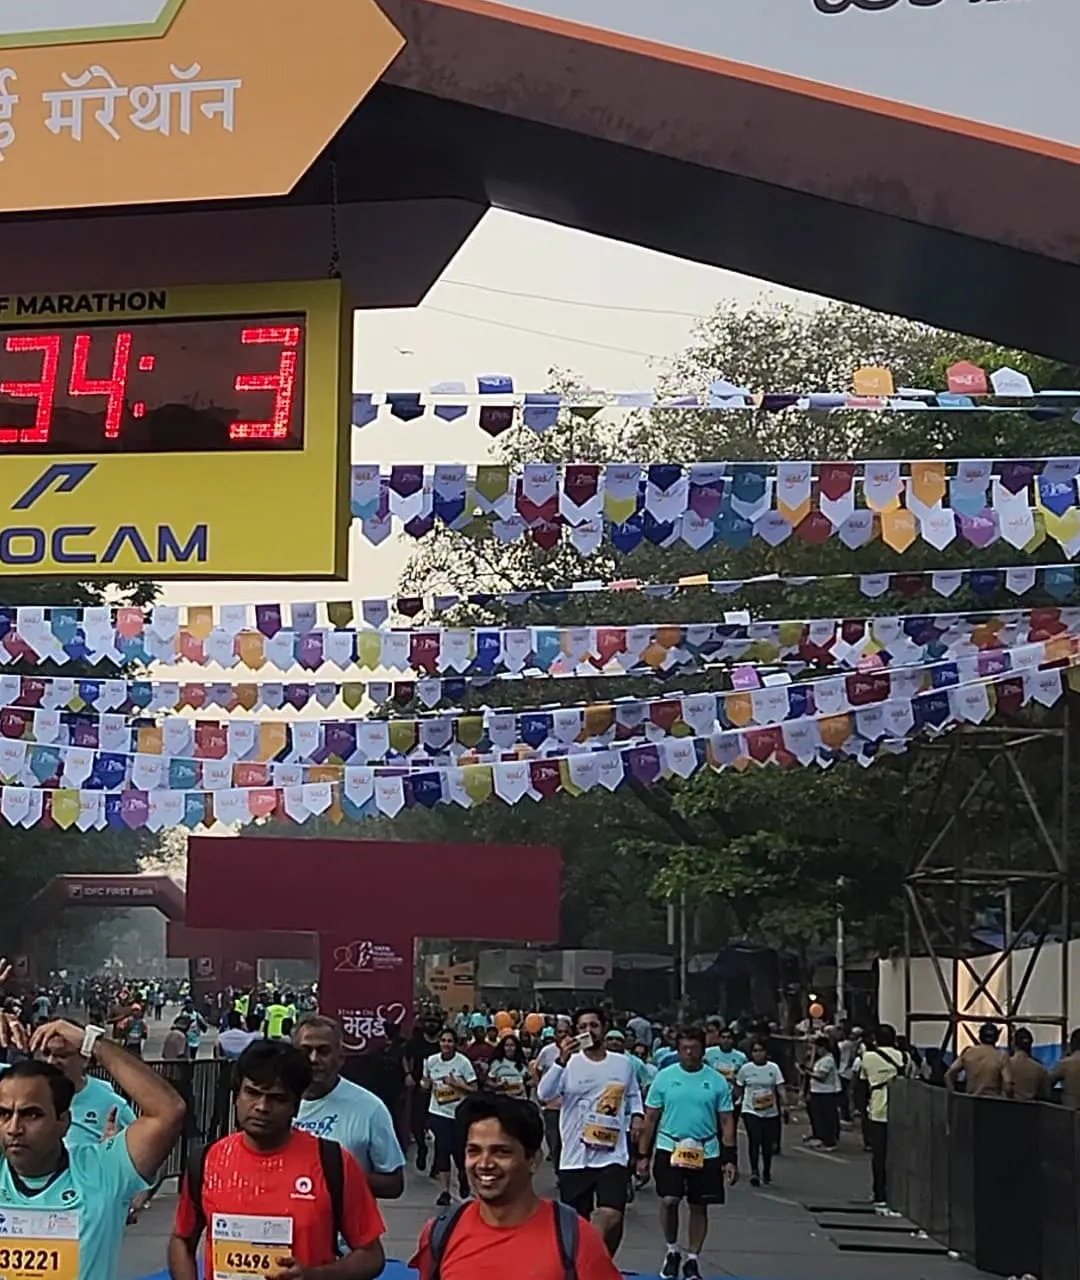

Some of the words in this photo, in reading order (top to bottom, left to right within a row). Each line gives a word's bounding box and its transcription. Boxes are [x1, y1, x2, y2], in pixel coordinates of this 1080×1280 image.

[43, 63, 242, 143] मॅरेथॉन
[16, 291, 167, 316] MARATHON
[106, 887, 131, 896] FIRST
[133, 886, 154, 896] Bank
[0, 1249, 59, 1271] 33221
[226, 1252, 270, 1269] 43496
